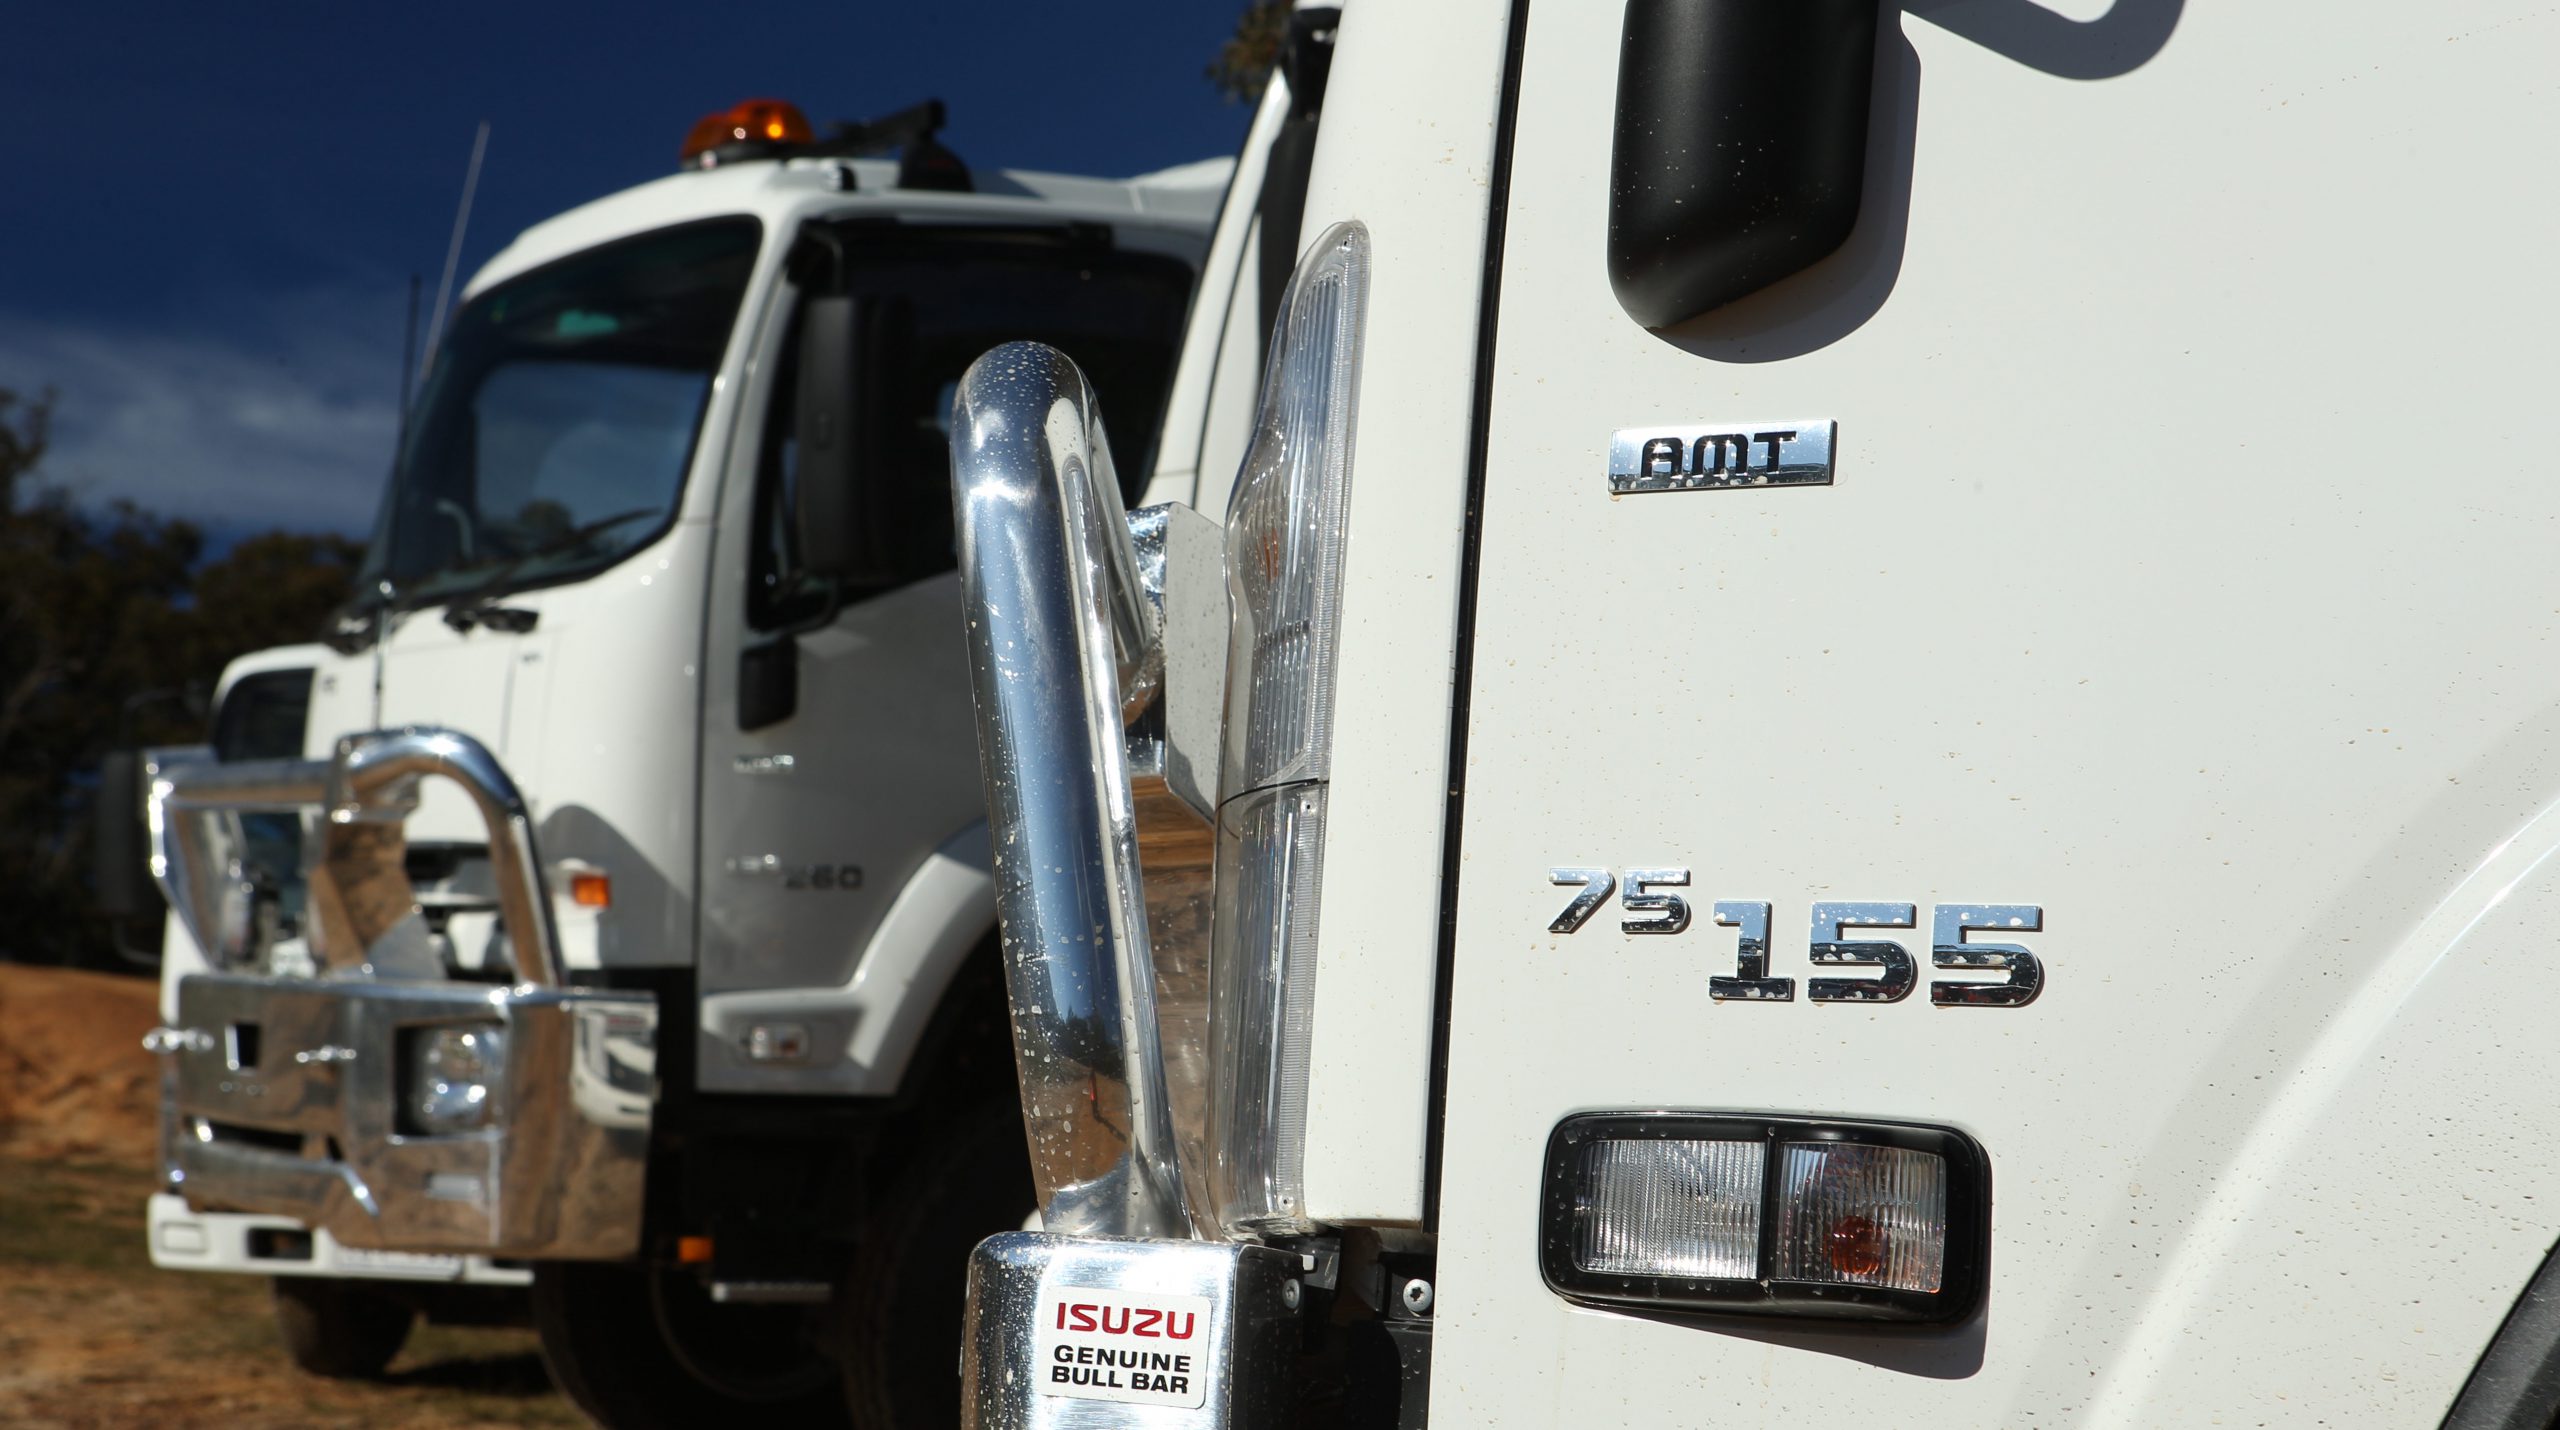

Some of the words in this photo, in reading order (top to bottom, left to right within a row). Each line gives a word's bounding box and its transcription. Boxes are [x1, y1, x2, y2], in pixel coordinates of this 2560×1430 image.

[1640, 431, 1798, 480] AMT
[1548, 867, 1692, 934] 75
[1708, 900, 2044, 1008] 155
[1056, 1302, 1195, 1340] ISUZU
[1053, 1344, 1191, 1373] GENUINE
[1051, 1365, 1123, 1388] BULL
[1131, 1372, 1189, 1394] BAR
